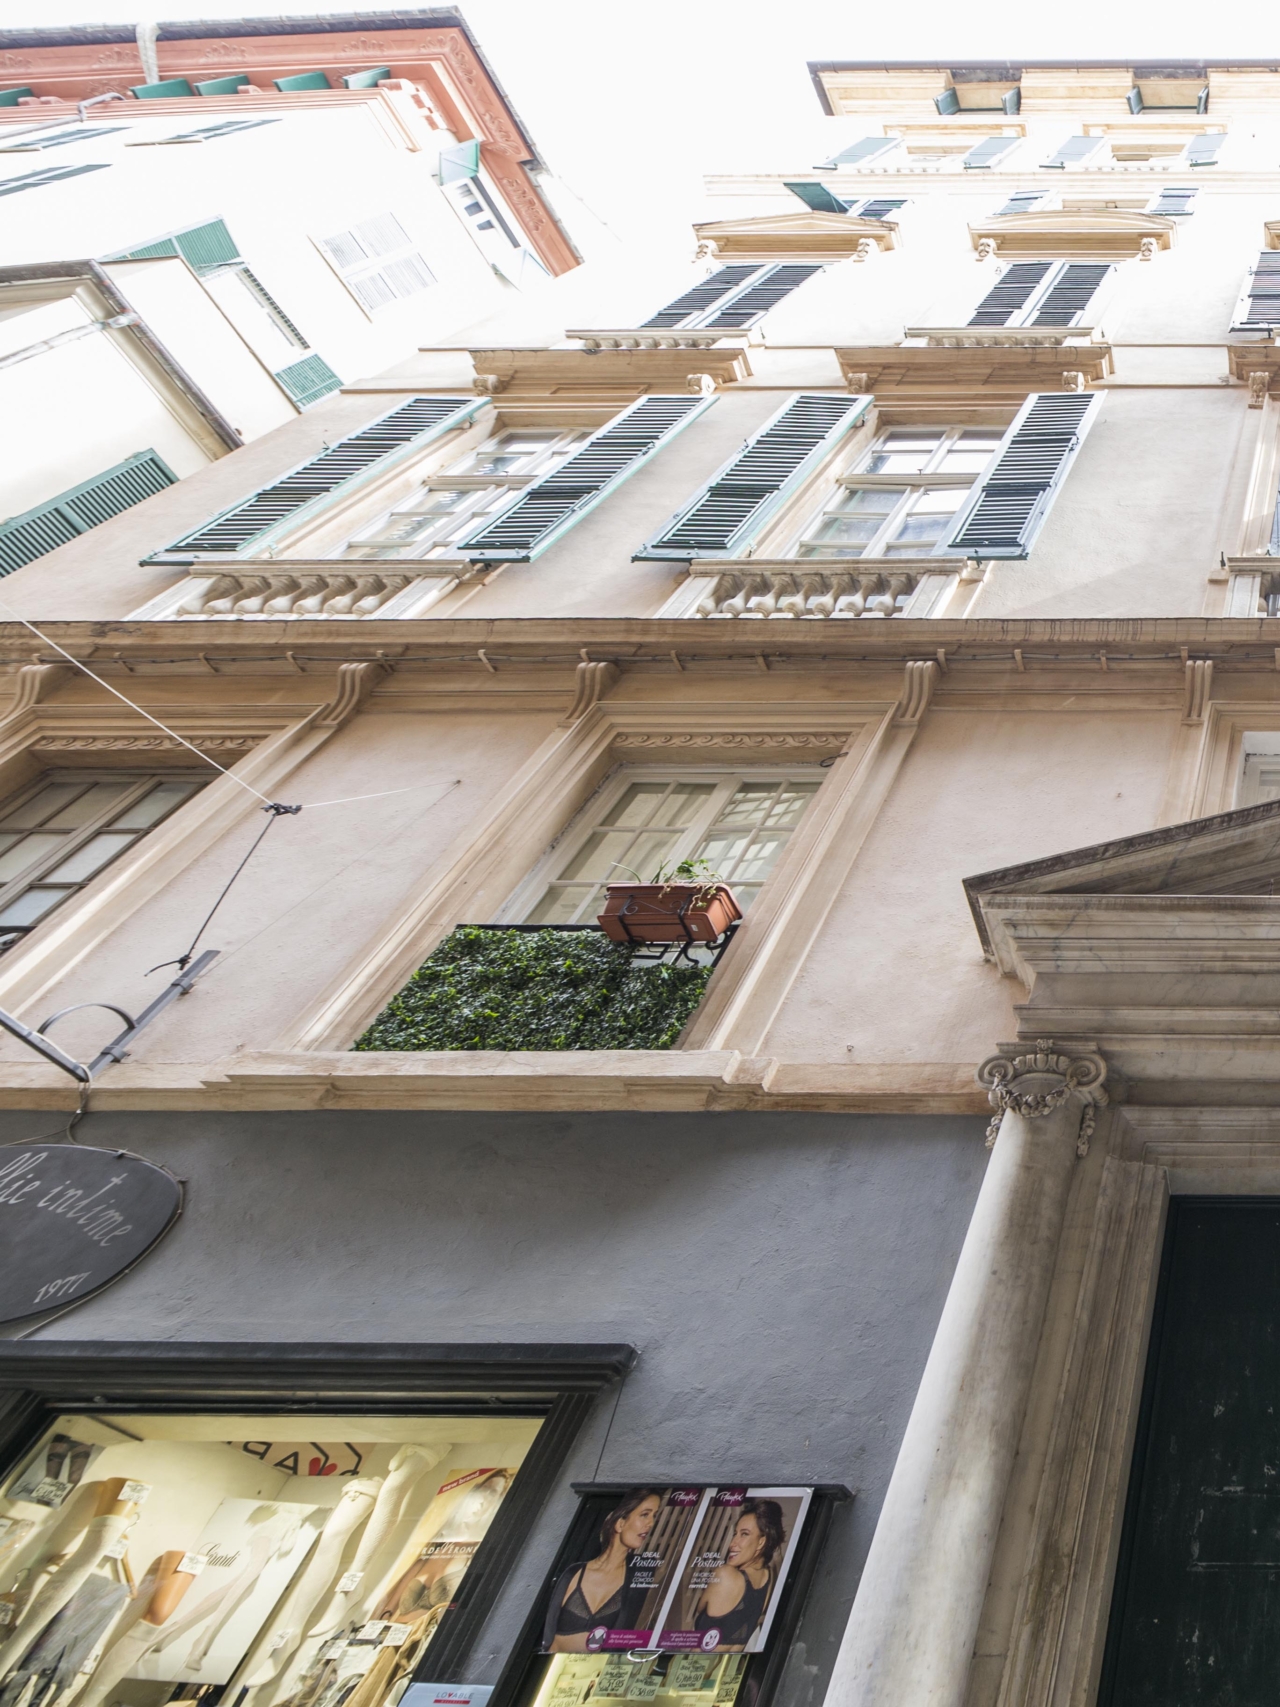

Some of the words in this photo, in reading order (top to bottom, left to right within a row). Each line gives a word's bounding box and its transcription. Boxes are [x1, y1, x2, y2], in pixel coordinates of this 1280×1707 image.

[37, 1172, 133, 1247] intime
[33, 1270, 92, 1304] 1977
[442, 1480, 458, 1492] new
[459, 1470, 480, 1485] brand
[629, 1555, 665, 1567] Posture
[690, 1556, 725, 1568] Posture
